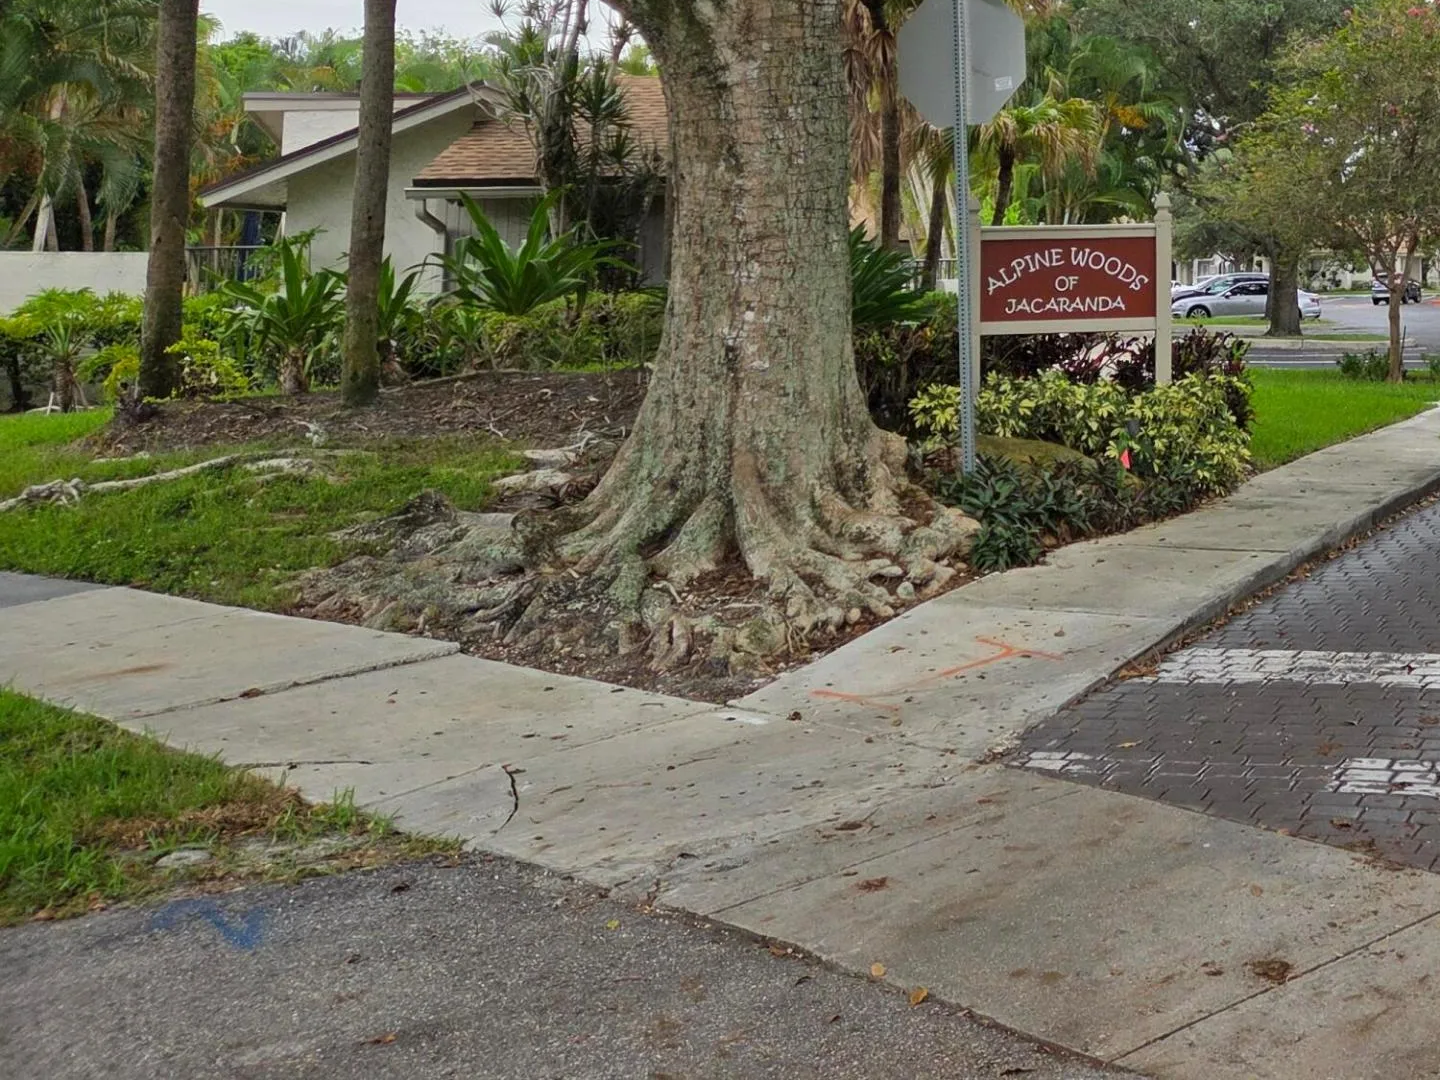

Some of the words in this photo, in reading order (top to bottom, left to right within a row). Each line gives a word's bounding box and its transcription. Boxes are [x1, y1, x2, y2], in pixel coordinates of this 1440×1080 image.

[986, 248, 1065, 296] ALPINE
[1070, 246, 1149, 292] WOODS
[1054, 275, 1080, 292] OF
[1004, 295, 1126, 314] JACARANDA
